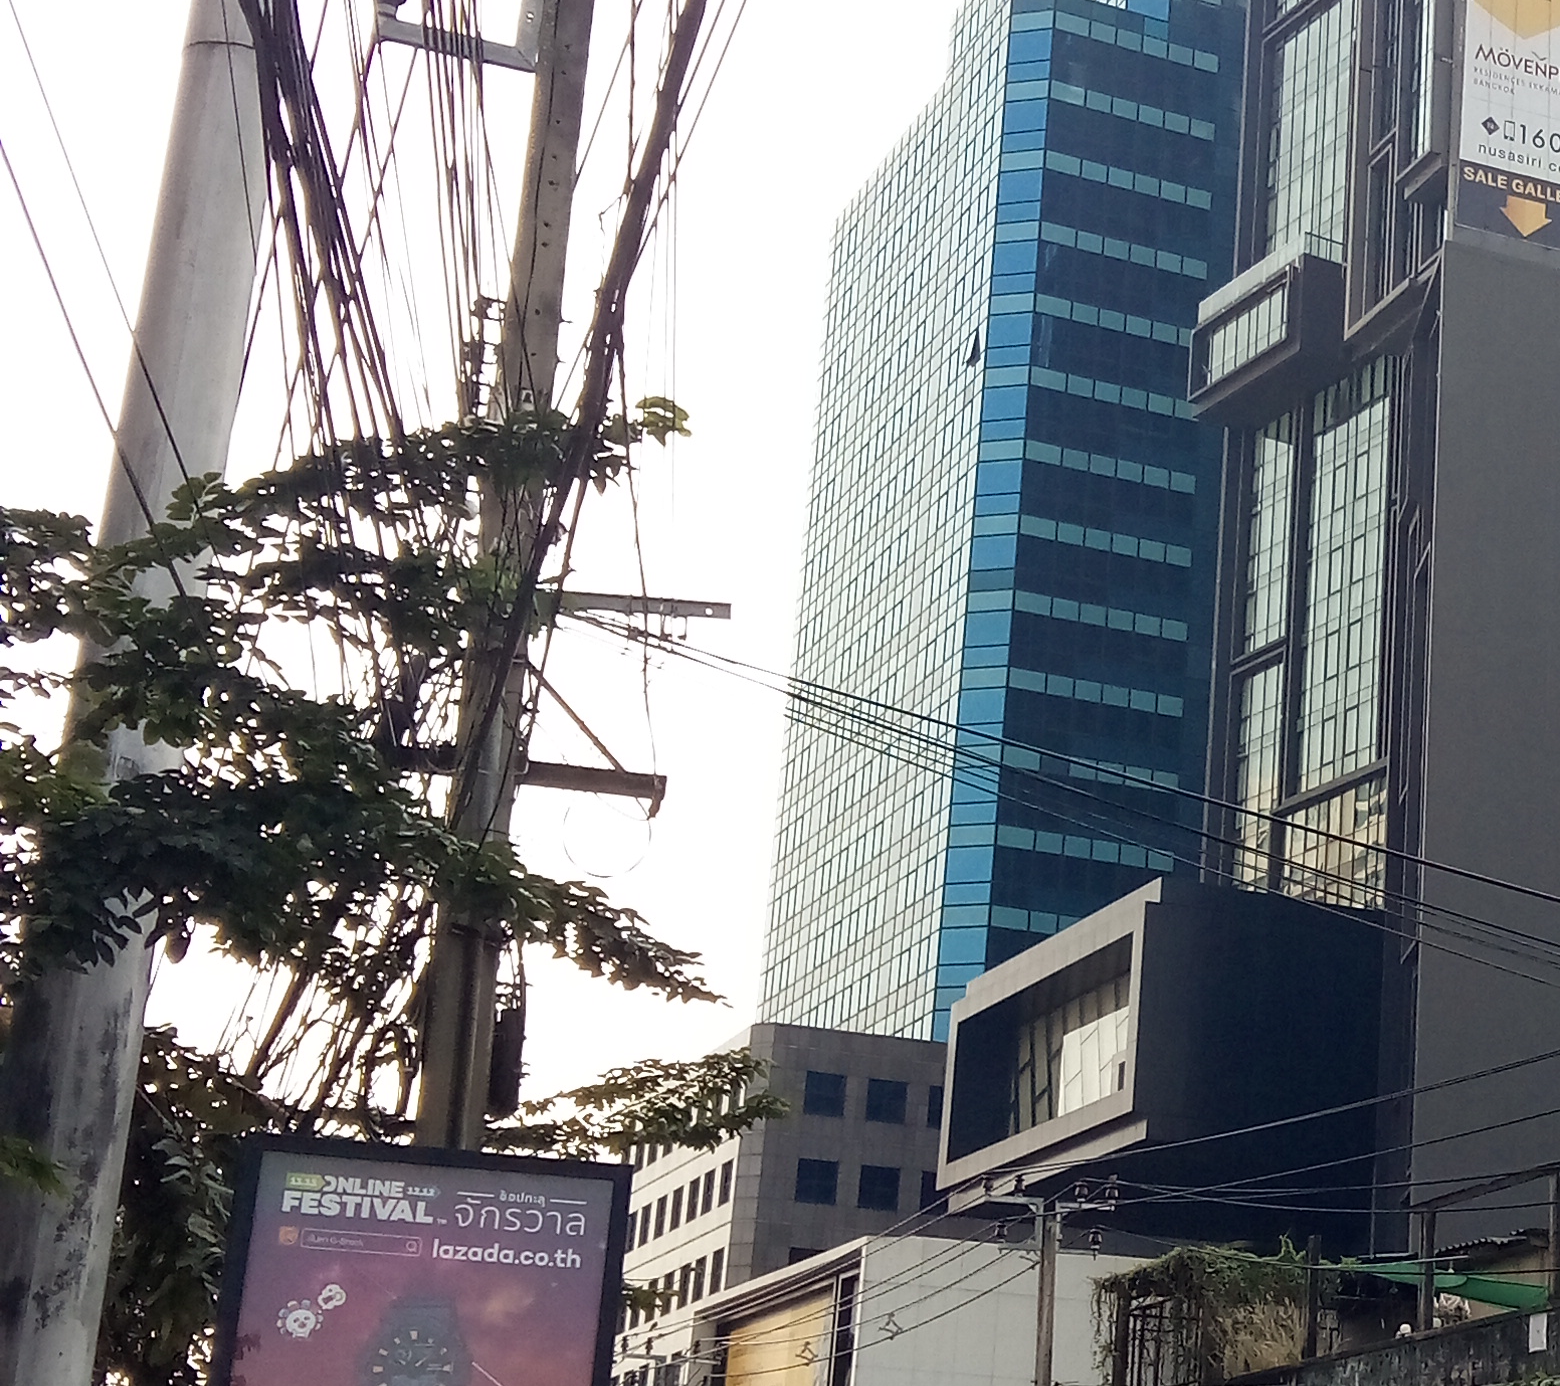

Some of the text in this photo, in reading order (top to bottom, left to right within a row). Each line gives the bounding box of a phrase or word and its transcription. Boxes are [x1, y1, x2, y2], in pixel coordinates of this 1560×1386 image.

[1463, 166, 1508, 190] SALE
[323, 1175, 405, 1198] ONLINE
[281, 1190, 434, 1224] FESTIVAL
[454, 1197, 586, 1236] จักรวาล
[432, 1238, 582, 1268] lazada.co.th
